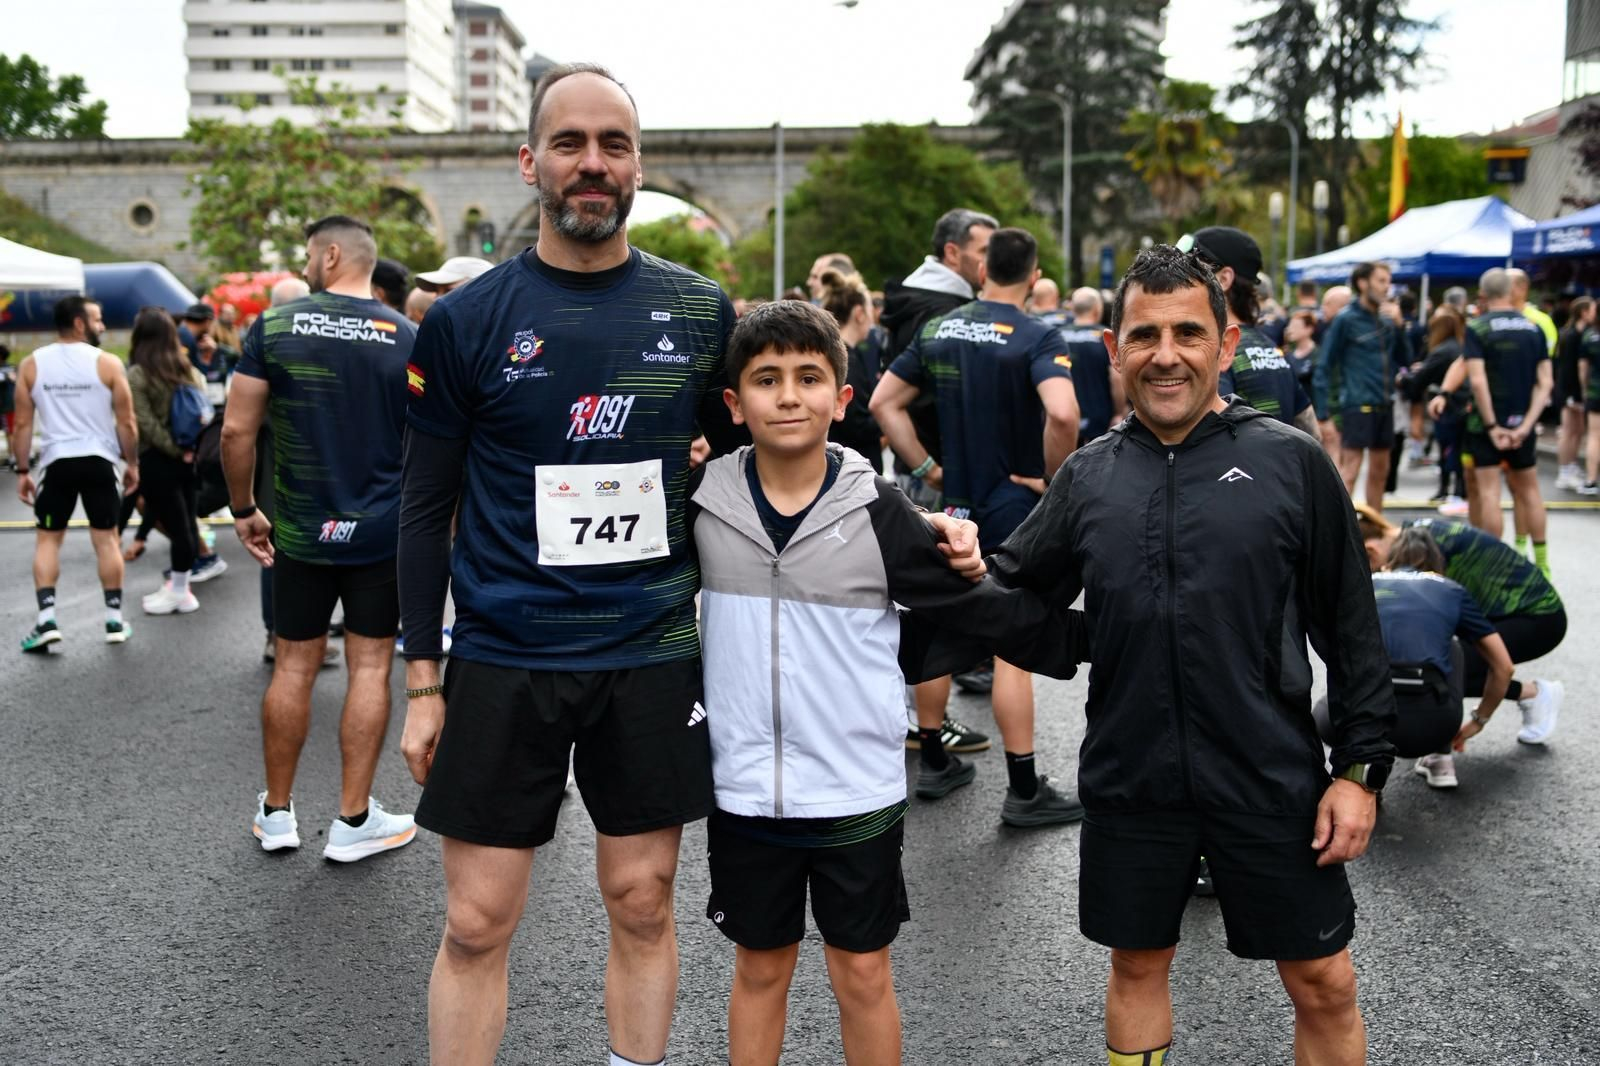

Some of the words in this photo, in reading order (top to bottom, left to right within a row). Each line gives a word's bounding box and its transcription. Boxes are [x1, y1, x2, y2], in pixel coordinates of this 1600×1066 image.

[293, 313, 375, 330] POLICIA
[292, 323, 396, 345] NACIONAL
[642, 351, 690, 363] Santander
[570, 514, 640, 545] 747
